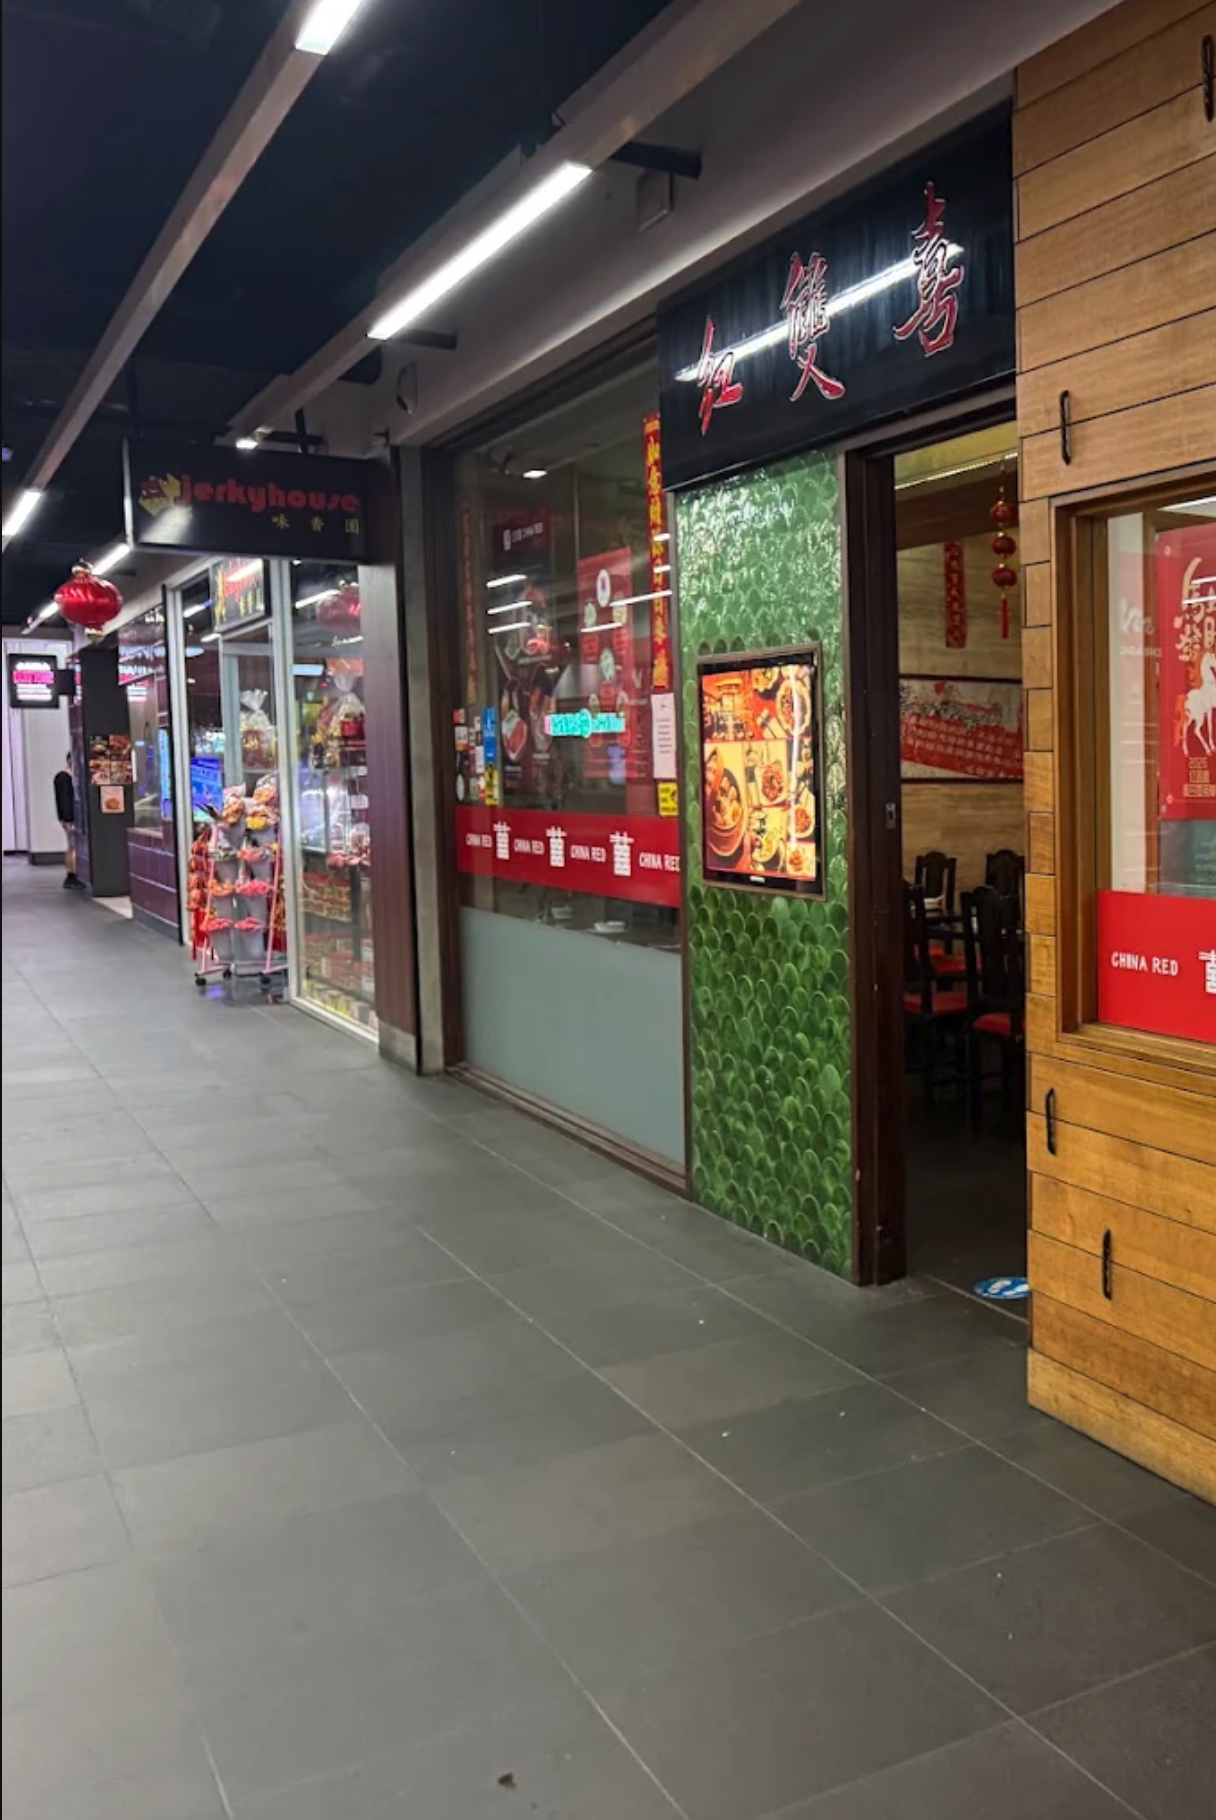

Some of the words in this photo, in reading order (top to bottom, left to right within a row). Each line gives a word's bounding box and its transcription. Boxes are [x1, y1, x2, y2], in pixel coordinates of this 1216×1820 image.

[176, 474, 359, 512] jerkyhouse
[570, 844, 590, 861] CHINA
[590, 846, 606, 863] RED
[639, 852, 662, 870] CHINA
[1110, 951, 1148, 972] CHINA
[1151, 956, 1179, 977] RED
